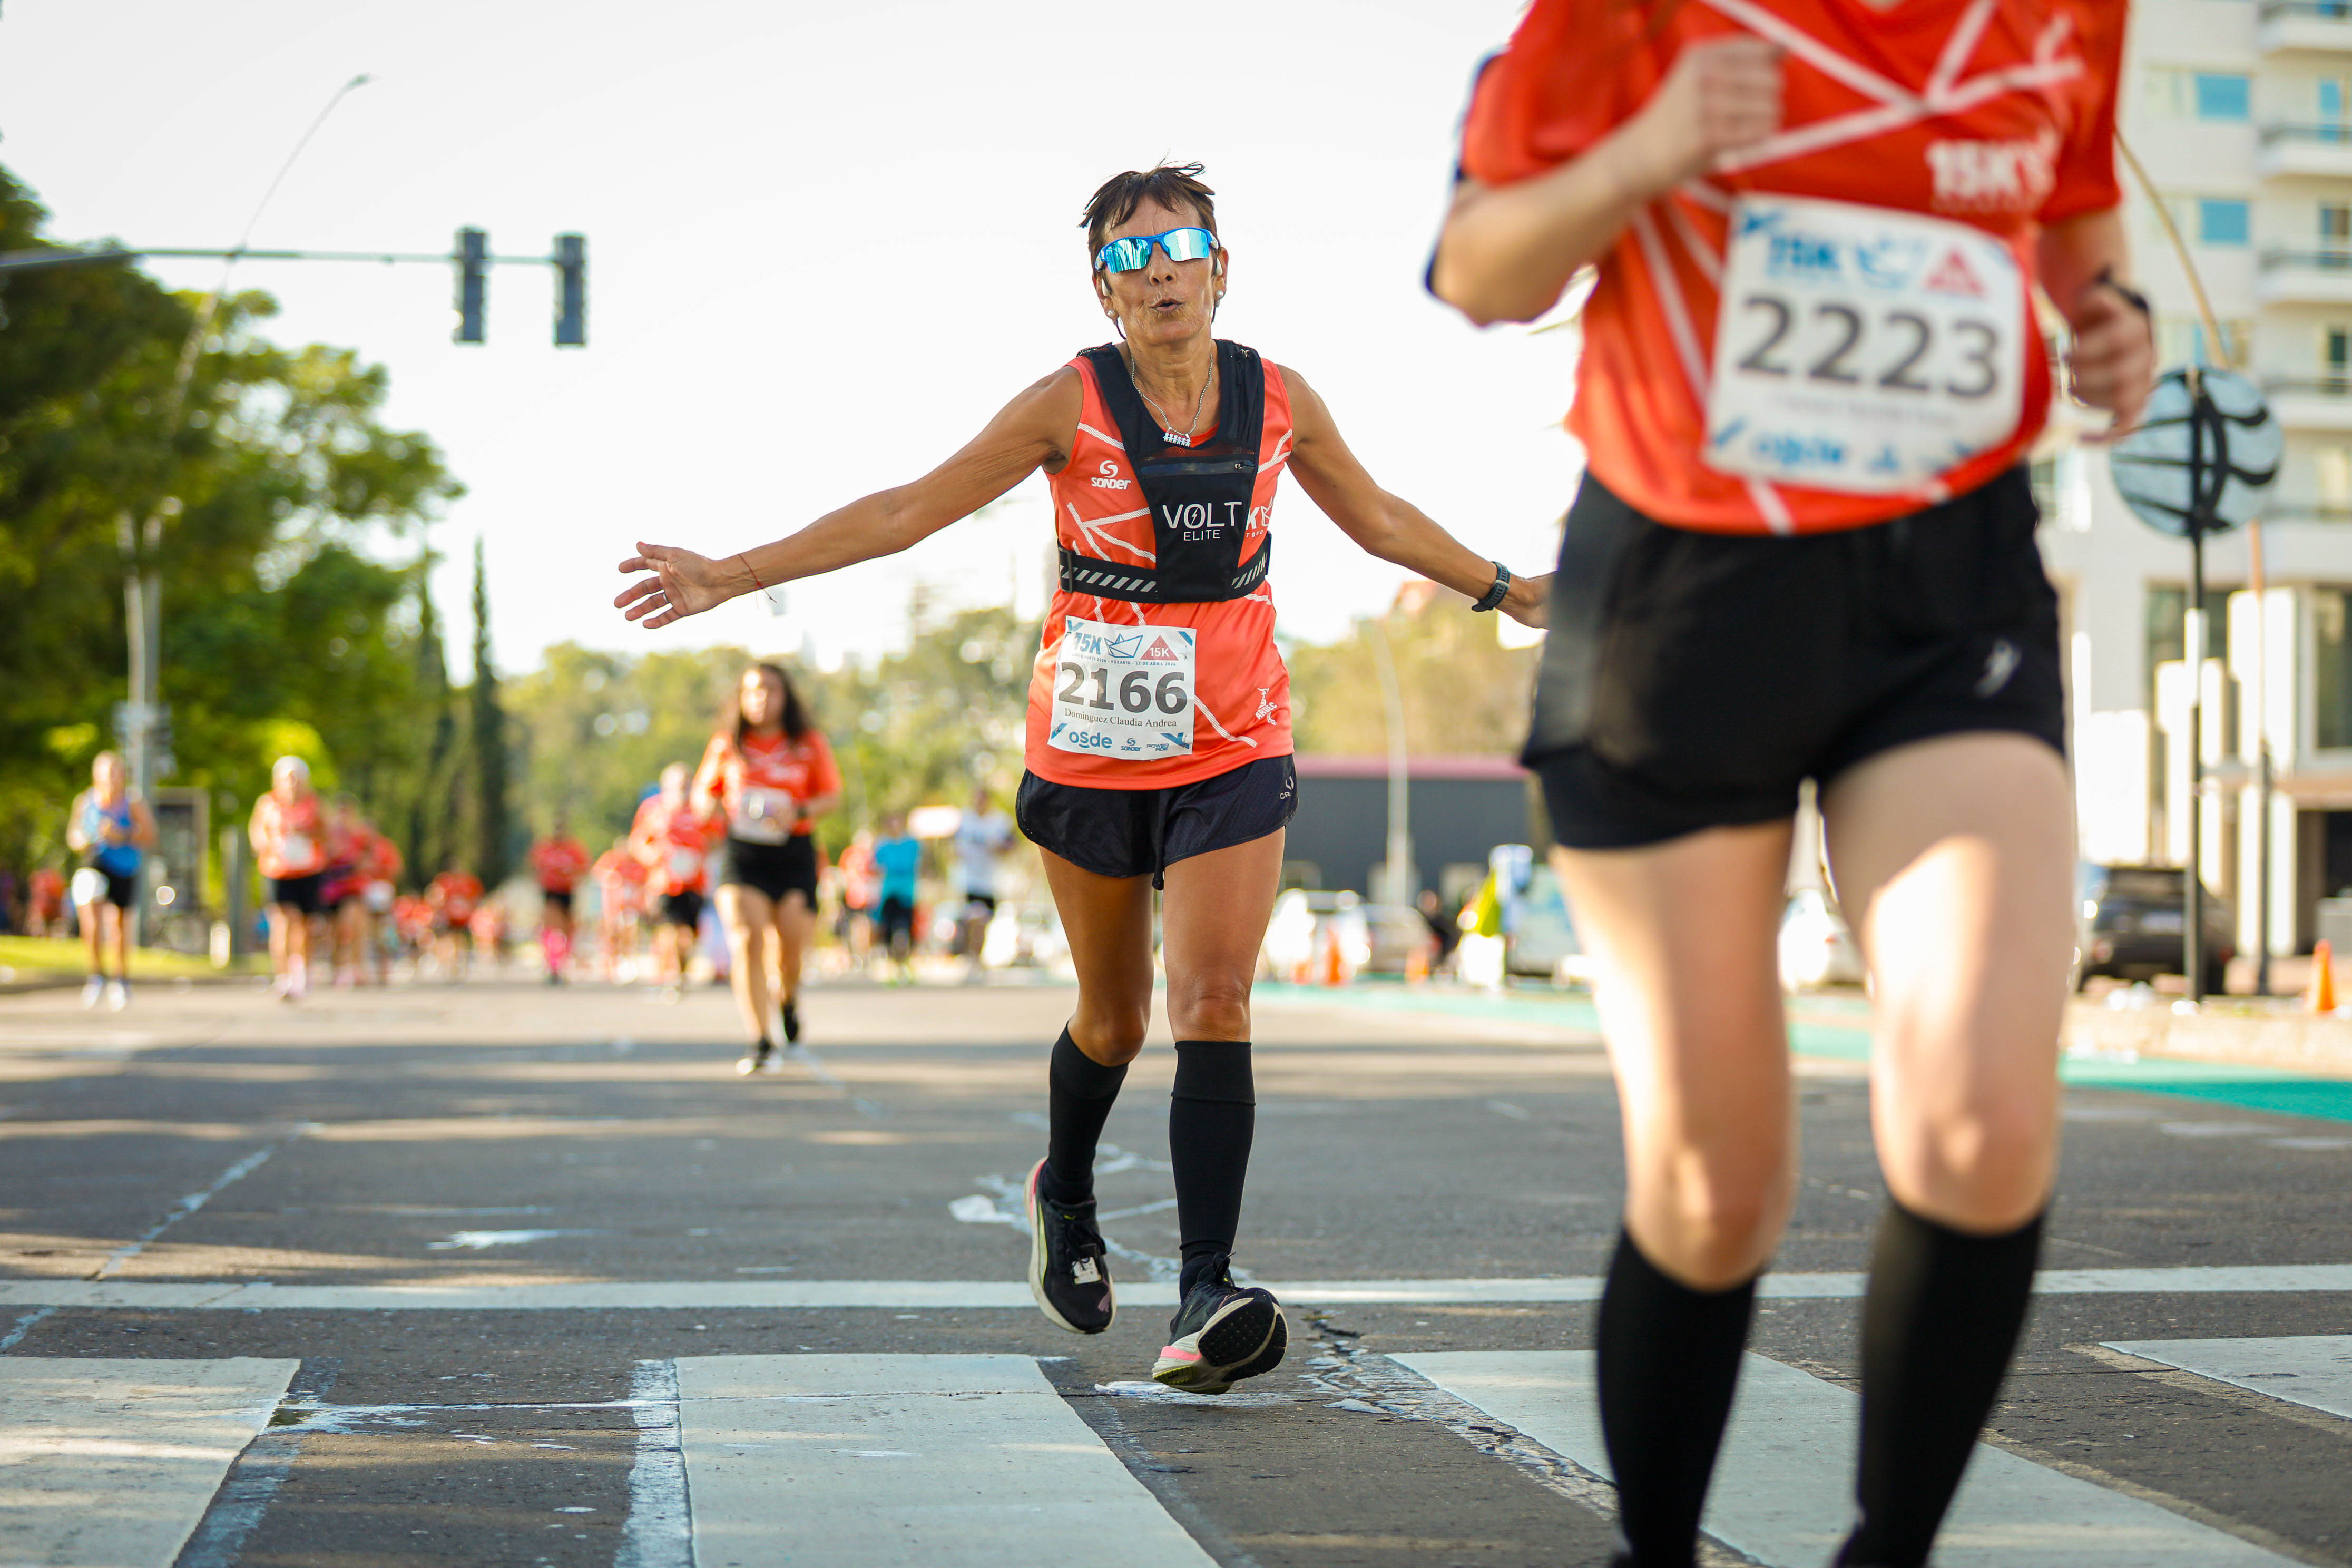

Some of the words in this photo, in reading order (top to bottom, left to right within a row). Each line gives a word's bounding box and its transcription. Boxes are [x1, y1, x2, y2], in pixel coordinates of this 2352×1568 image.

[1736, 294, 2001, 399] 2223
[1162, 502, 1242, 529] VOLT
[1183, 529, 1221, 541] ELITE
[1149, 647, 1170, 658] 15K
[1059, 662, 1188, 714] 2166
[1065, 708, 1108, 723] Dominguez
[1110, 716, 1142, 727] Claudia
[1069, 731, 1113, 749] osde
